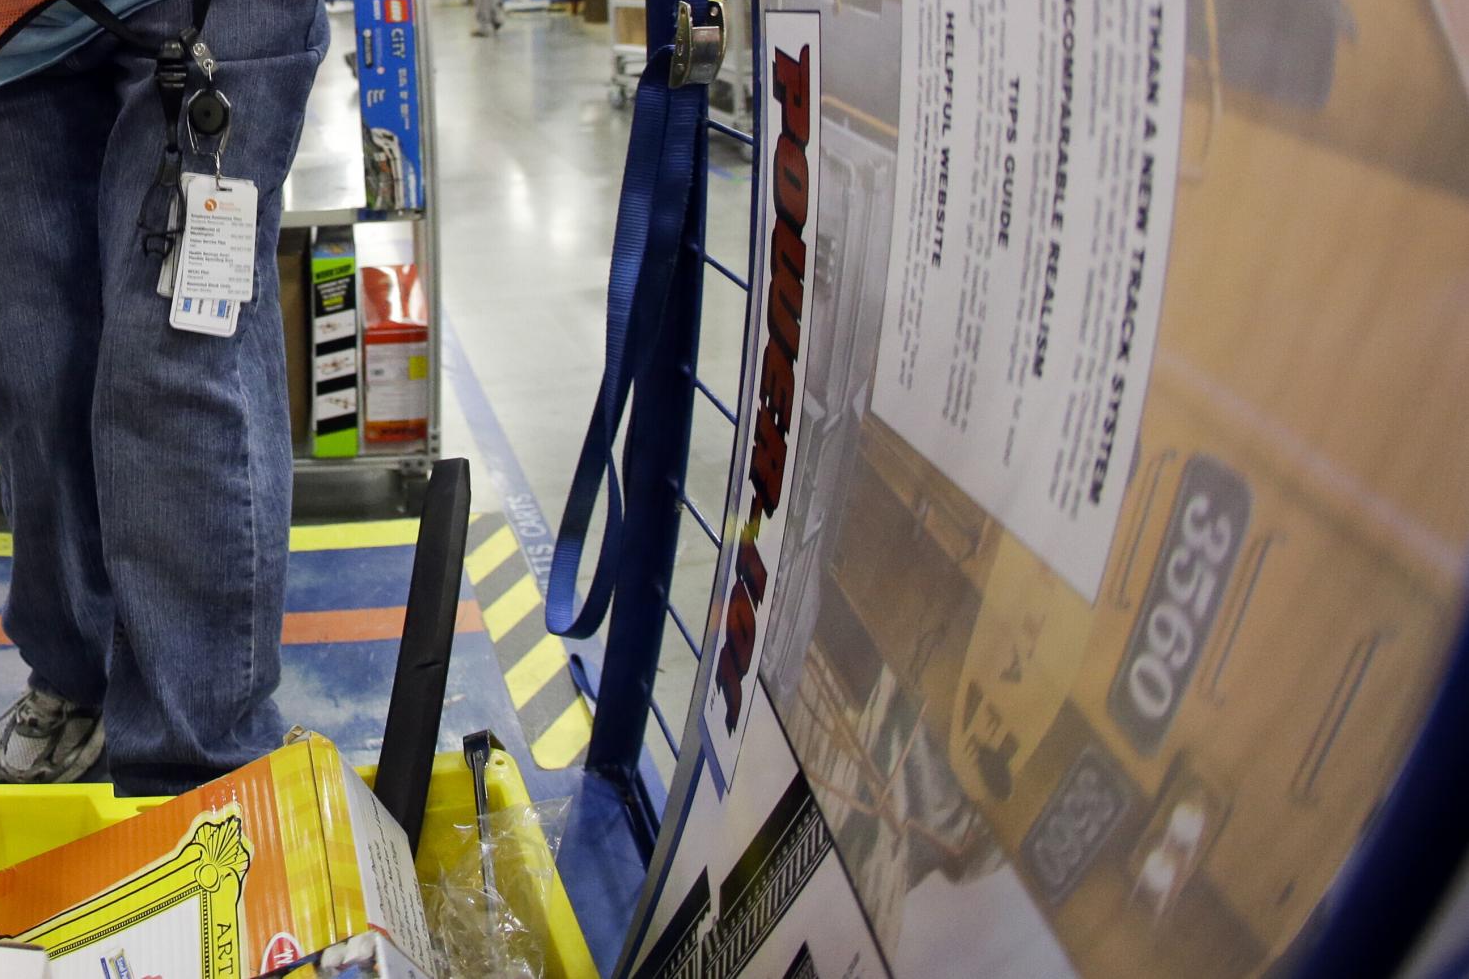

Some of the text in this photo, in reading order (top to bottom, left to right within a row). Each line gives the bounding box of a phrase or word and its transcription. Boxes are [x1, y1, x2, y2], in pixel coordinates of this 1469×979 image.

[1145, 0, 1162, 105] THAN
[931, 10, 955, 270] HELPFUL WEBSITE
[996, 74, 1020, 251] TIPS GUIDE
[1134, 150, 1155, 236] NEW
[1142, 112, 1158, 145] A
[1029, 238, 1062, 380] REALISM
[1115, 243, 1146, 367] TRACK
[1085, 369, 1128, 510] SYSTEM
[1129, 492, 1230, 720] 3560
